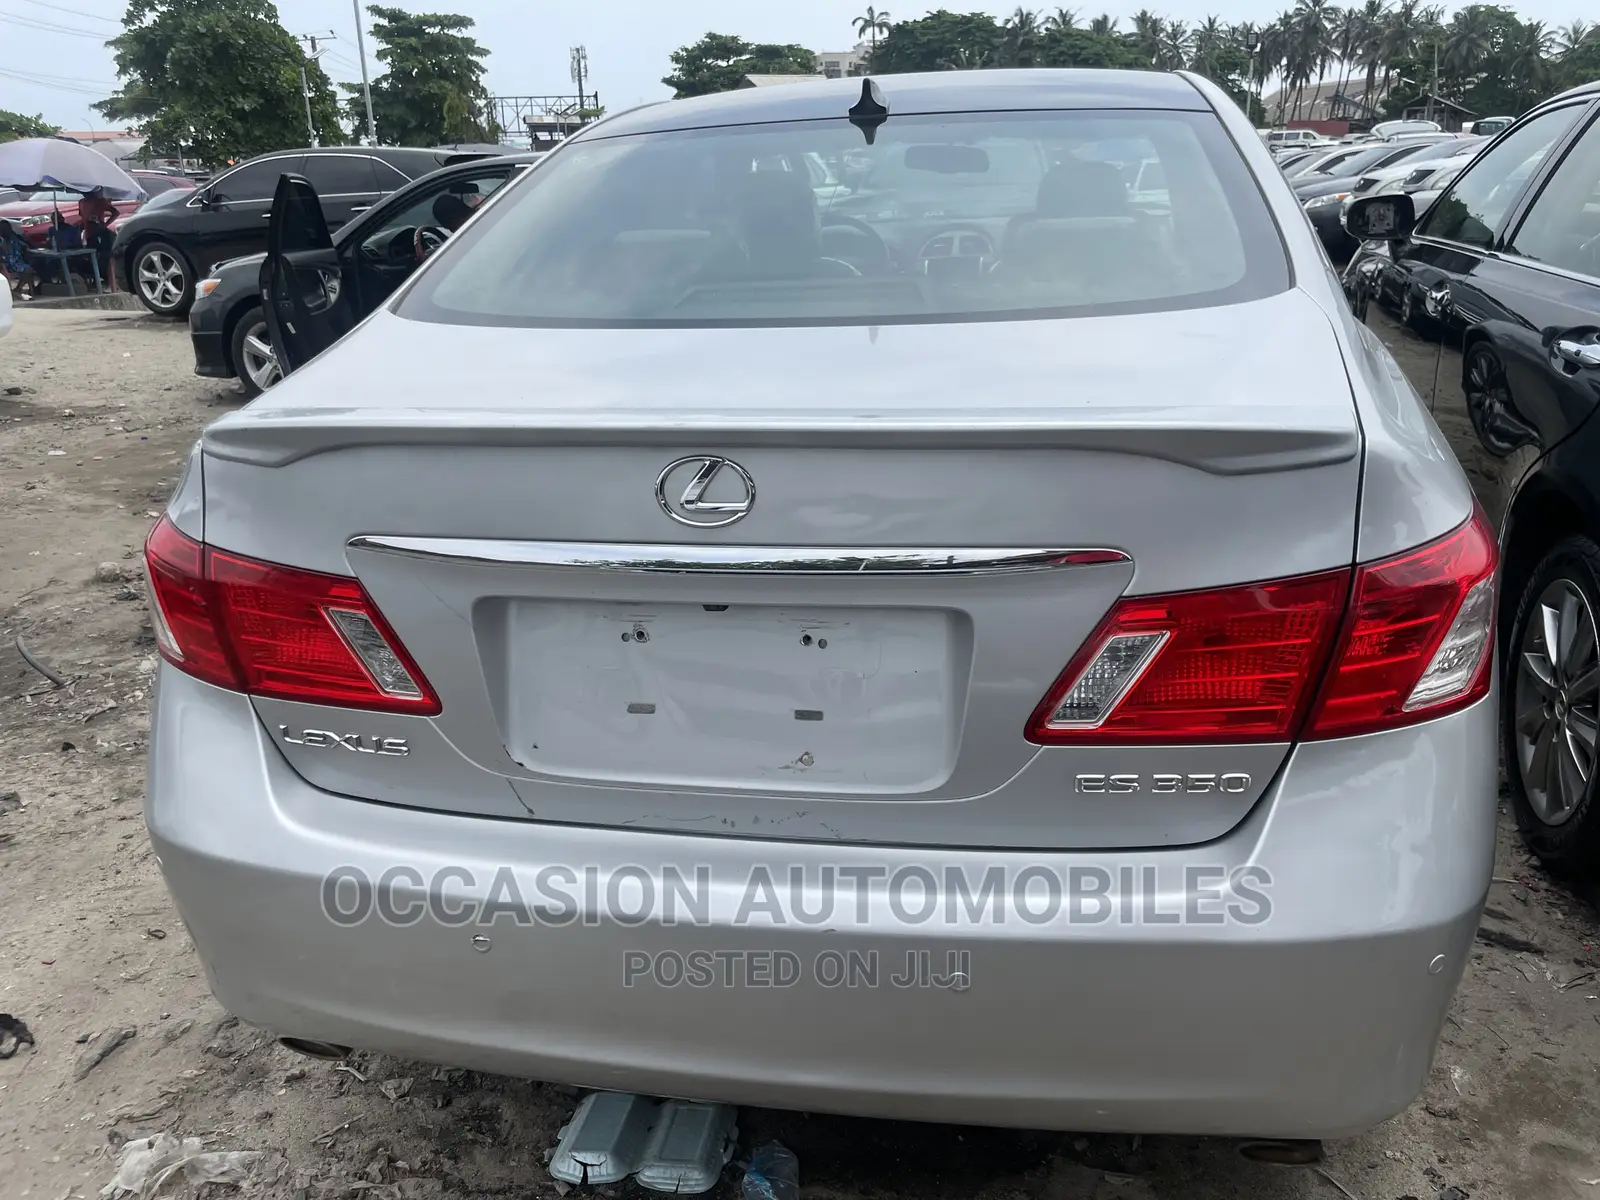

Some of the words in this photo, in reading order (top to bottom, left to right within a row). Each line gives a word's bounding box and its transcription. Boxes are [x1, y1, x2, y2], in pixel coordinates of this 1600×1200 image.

[278, 724, 411, 757] LEXUS
[1074, 773, 1140, 794] ES
[1151, 772, 1252, 794] 350
